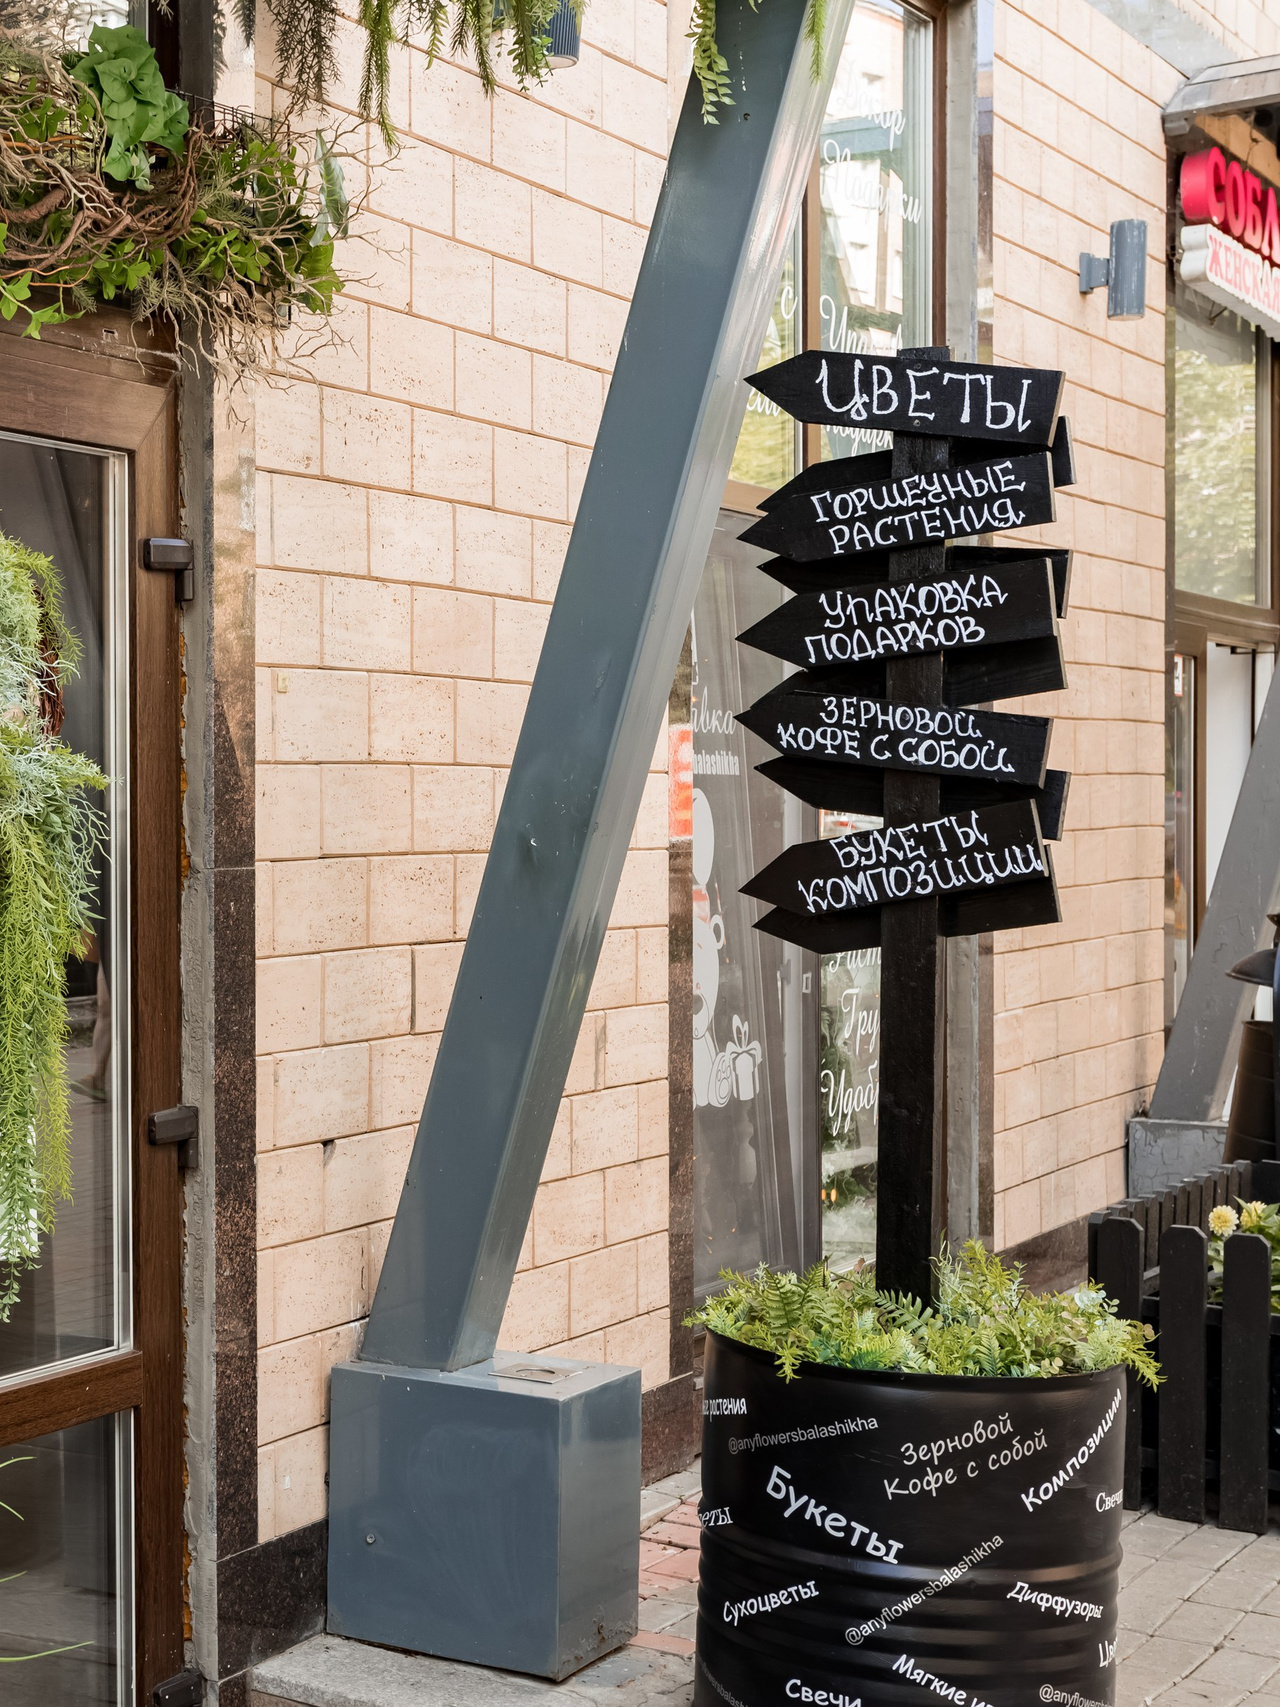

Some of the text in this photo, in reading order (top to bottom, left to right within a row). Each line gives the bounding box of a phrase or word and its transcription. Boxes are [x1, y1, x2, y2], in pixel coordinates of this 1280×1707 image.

[815, 359, 1032, 432] ЦВЕТЫ
[810, 461, 1025, 522] ГОРШЕЧНЫЕ
[827, 499, 1025, 554] РАСТЕНИЯ
[804, 615, 985, 663] ПОДАРКОВ
[820, 697, 982, 738] ЗЕРНОВОЙ
[777, 723, 1015, 773] КОФЕ С СОБОЙ
[830, 811, 988, 867] БУКЕТЫ
[798, 845, 1044, 913] КОМПОЗИЦИИ
[728, 1417, 879, 1455] @anyflowersbalashikha
[901, 1412, 1013, 1465] Зерновой
[1021, 1388, 1121, 1512] Композиции
[884, 1428, 1048, 1501] Кофе с собой
[766, 1464, 904, 1565] Букеты
[723, 1580, 819, 1626] Сухоцветы
[845, 1535, 1004, 1645] @anyflowersbalashikha
[1006, 1581, 1104, 1622] Диффузоры
[785, 1678, 862, 1707] Свечи
[892, 1653, 967, 1706] Мягкие
